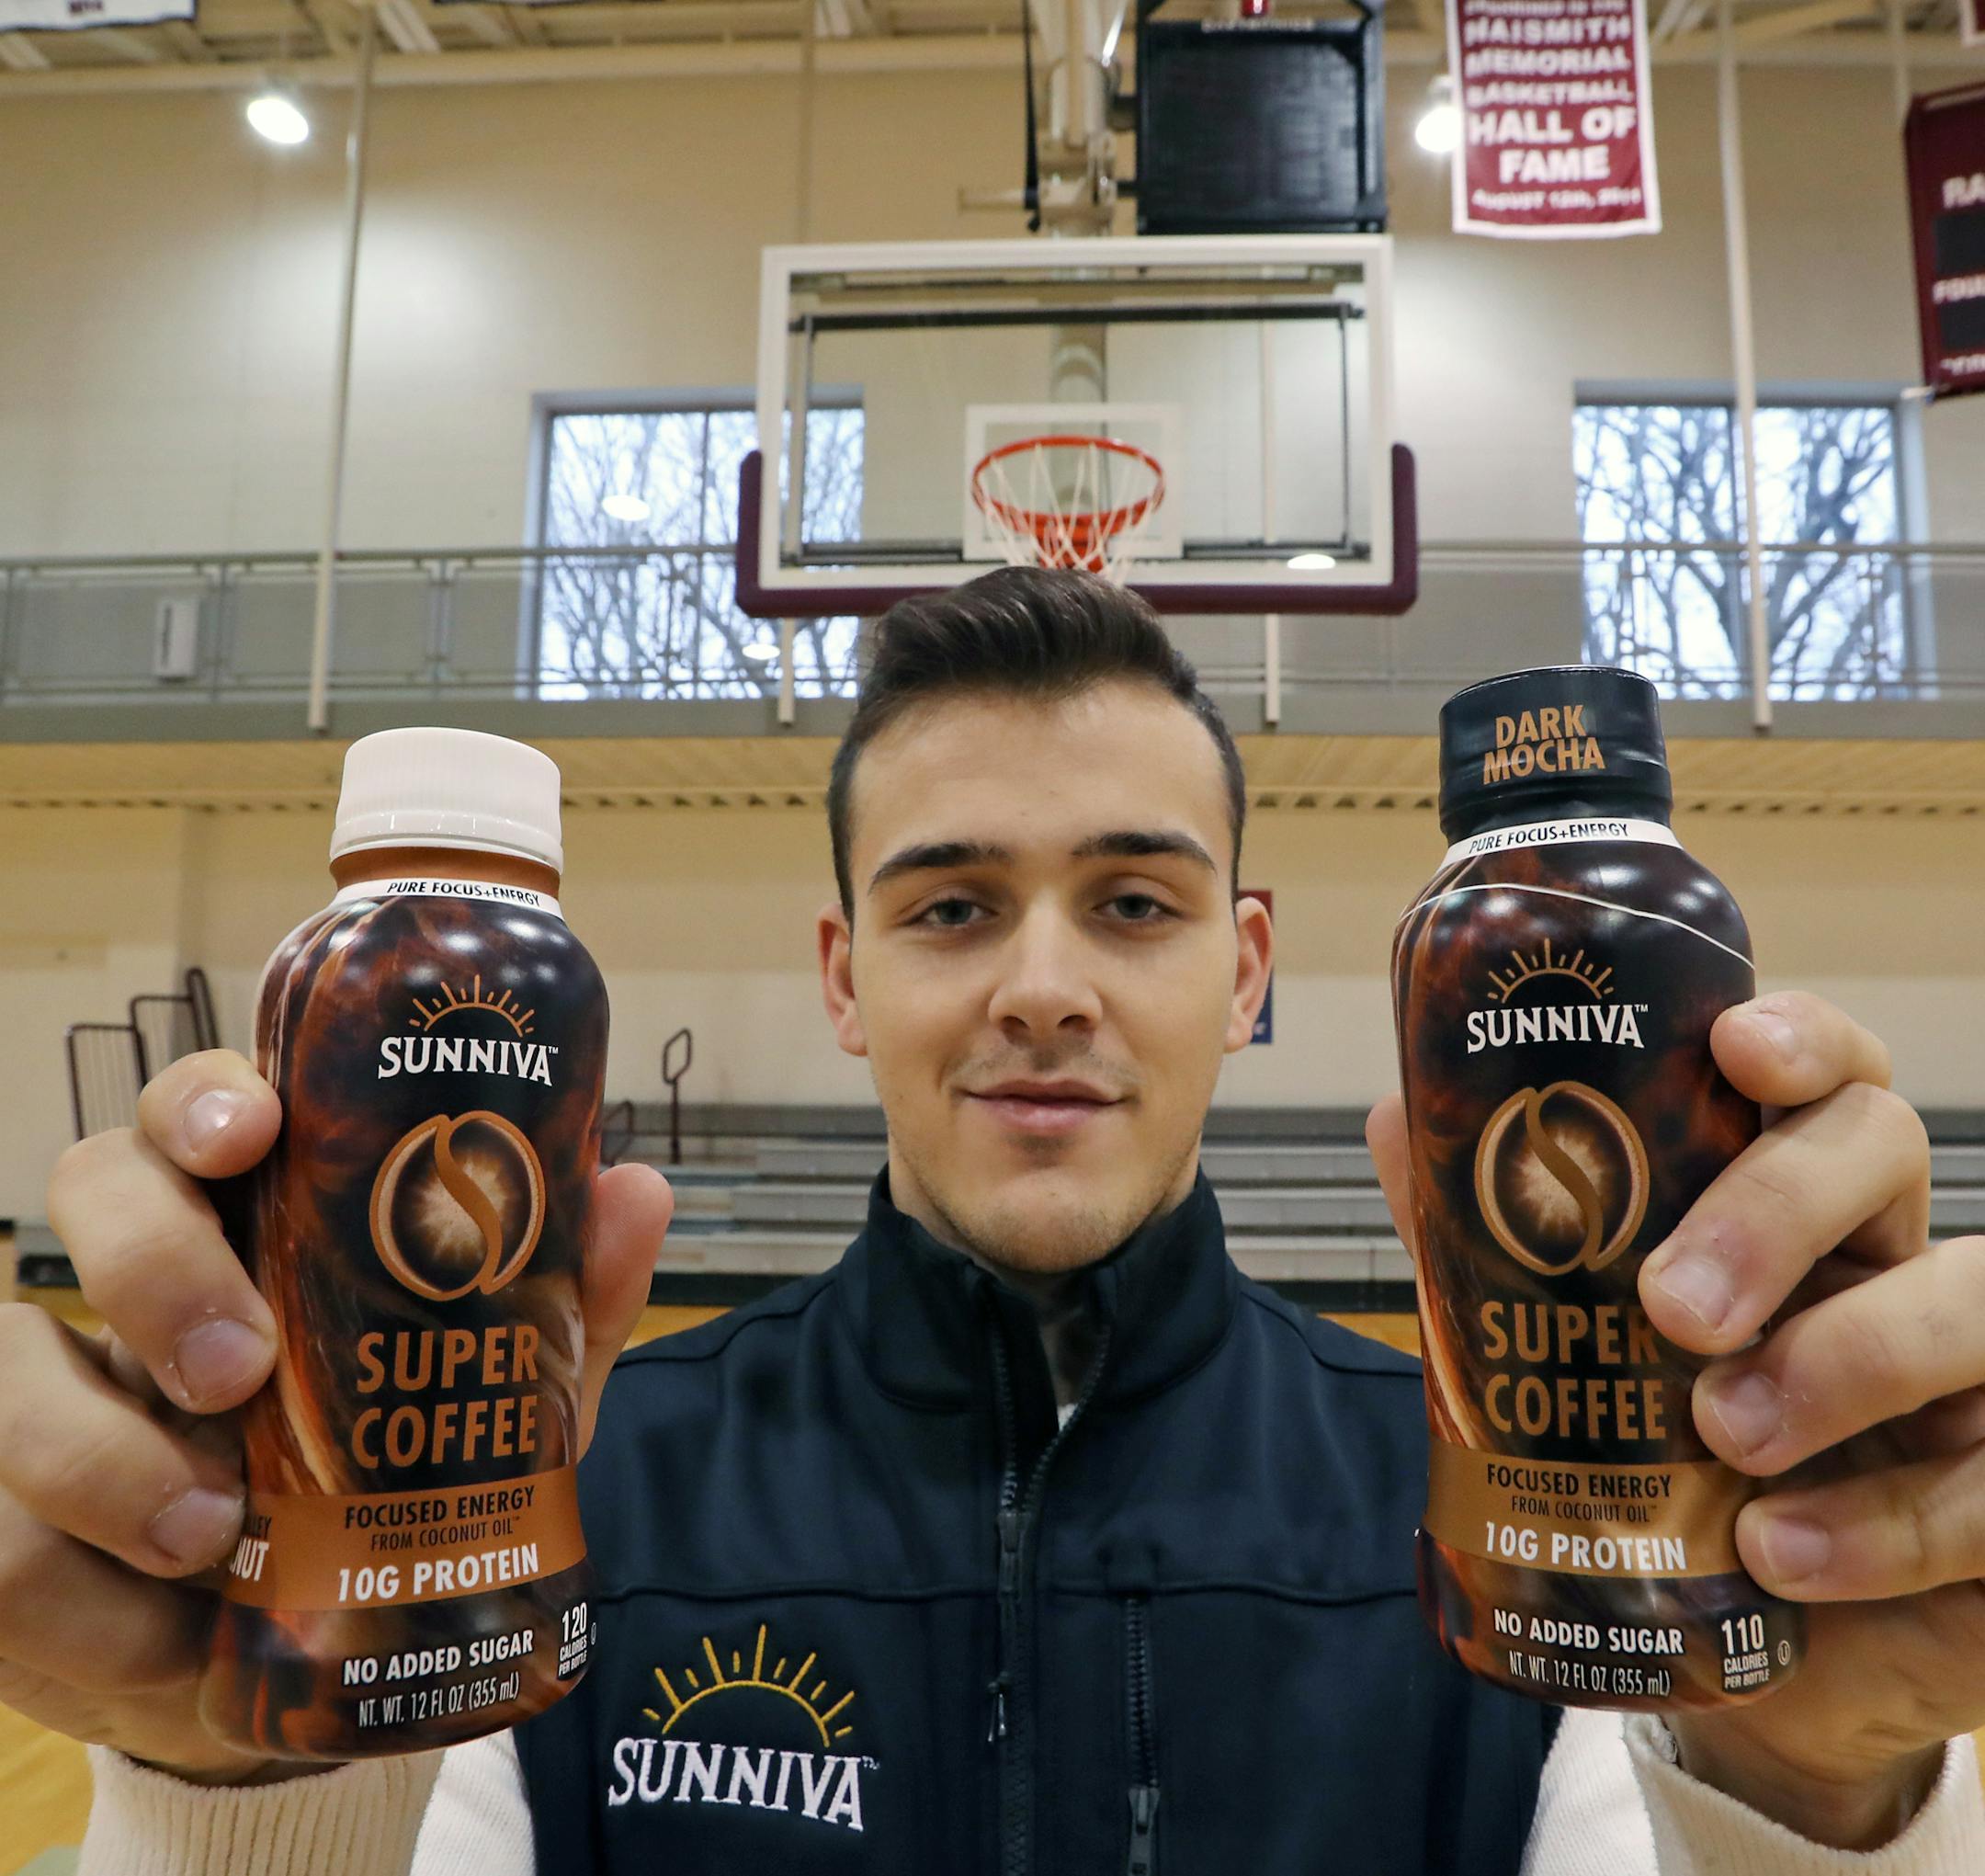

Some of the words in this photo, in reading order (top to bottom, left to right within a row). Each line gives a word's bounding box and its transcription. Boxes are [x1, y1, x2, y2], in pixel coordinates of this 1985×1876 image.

[1464, 15, 1631, 48] NAISMITH
[1465, 45, 1631, 78] MEMORIAL
[1466, 78, 1634, 108] BASKETBALL
[1469, 108, 1574, 147] HALL
[1582, 106, 1637, 141] OF
[1499, 144, 1610, 185] FAME
[1495, 704, 1587, 748] DARK
[1482, 737, 1605, 785] MOCHA
[1469, 834, 1503, 854] PURE
[387, 881, 427, 893] PURE
[1480, 1300, 1662, 1365] SUPER
[357, 1325, 539, 1394] SUPER
[1484, 1373, 1667, 1440] COFFEE
[352, 1395, 538, 1470] COFFEE
[1487, 1463, 1580, 1495] FOCUSED
[1588, 1474, 1672, 1498] ENERGY
[345, 1500, 448, 1529] FOCUSED
[457, 1485, 535, 1519] ENERGY
[1512, 1495, 1549, 1517] FROM
[1555, 1501, 1620, 1523] COCONUT
[371, 1531, 413, 1552] FROM
[419, 1522, 488, 1548] COCONUT
[1485, 1521, 1539, 1562] 10G
[1551, 1532, 1687, 1572] PROTEIN
[338, 1566, 400, 1602] 10G
[414, 1542, 539, 1596] PROTEIN
[561, 1602, 587, 1643] 120
[1493, 1609, 1523, 1636] NO
[1529, 1617, 1600, 1650] ADDED
[1608, 1627, 1684, 1654] SUGAR
[1721, 1614, 1764, 1654] 110
[343, 1657, 378, 1687] NO
[385, 1646, 461, 1681] ADDED
[469, 1630, 534, 1667] SUGAR
[1509, 1650, 1527, 1678] NT.
[1528, 1654, 1550, 1683] WT.
[1553, 1659, 1570, 1688] 12
[1572, 1663, 1588, 1690] FL
[1591, 1666, 1608, 1692] OZ
[1612, 1667, 1643, 1695] (355
[1647, 1669, 1671, 1697] mL)
[1724, 1651, 1769, 1674] CALORIES
[358, 1699, 378, 1727] NT.
[382, 1695, 405, 1724] WT.
[411, 1691, 426, 1721] 12
[430, 1689, 444, 1718] FL
[448, 1684, 465, 1713] OZ
[469, 1677, 497, 1711] (355
[499, 1671, 520, 1701] mL)
[1724, 1675, 1741, 1688] PER
